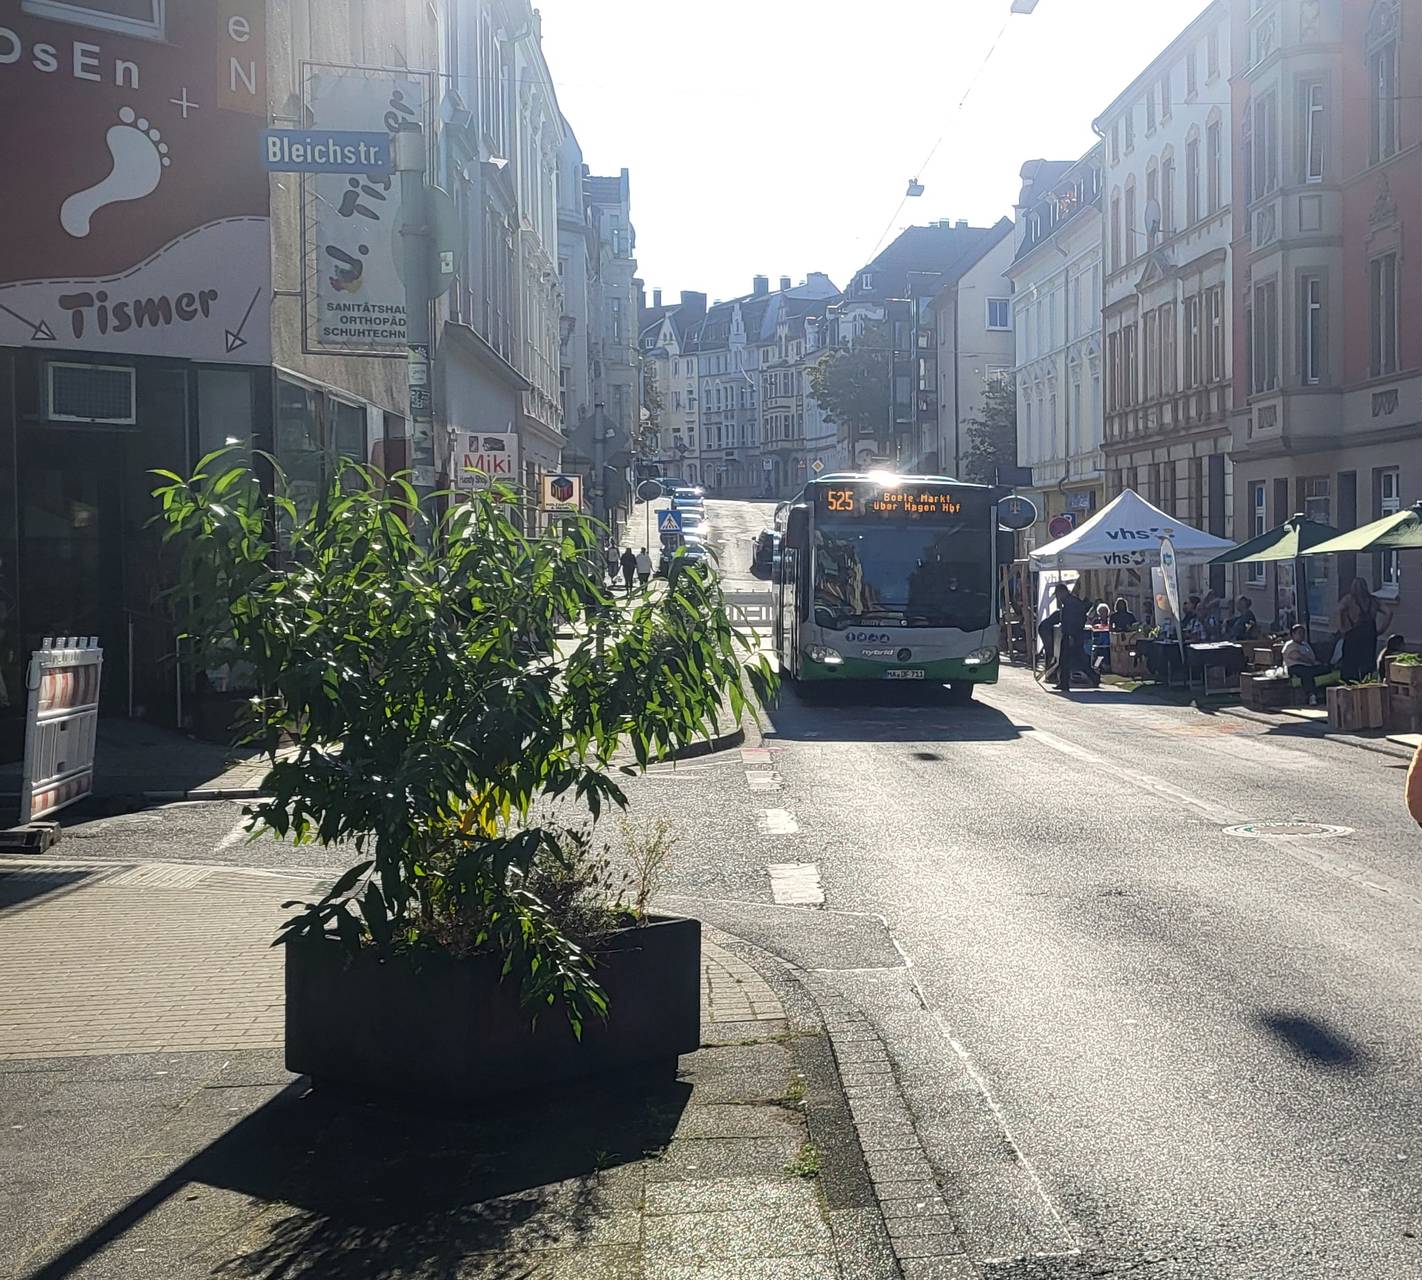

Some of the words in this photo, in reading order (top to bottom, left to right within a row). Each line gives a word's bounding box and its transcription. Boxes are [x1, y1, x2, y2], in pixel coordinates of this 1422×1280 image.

[267, 136, 383, 165] Bleichstr.
[58, 289, 218, 339] Tismer
[463, 454, 512, 474] Miki
[827, 491, 854, 511] 525
[883, 492, 914, 502] Boele
[920, 494, 951, 503] Markt
[904, 502, 936, 512] Hagen
[941, 503, 961, 513] Hbf
[1105, 527, 1151, 540] vhs
[1103, 551, 1131, 565] vhs
